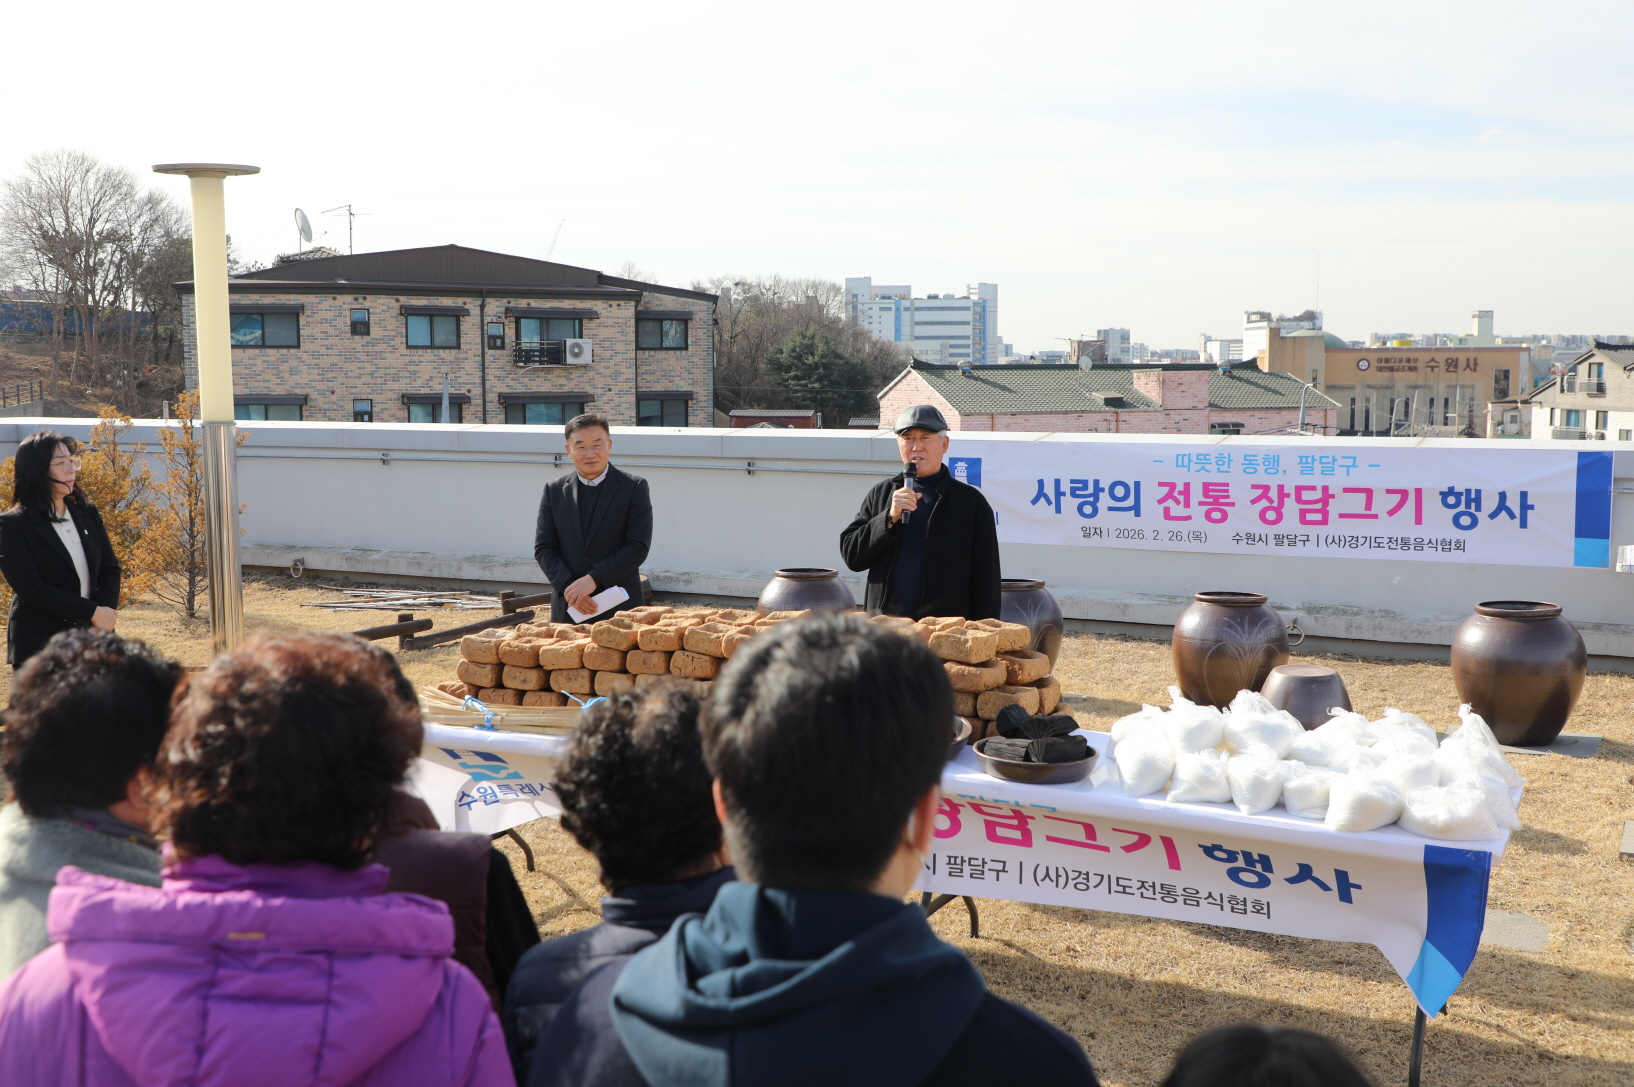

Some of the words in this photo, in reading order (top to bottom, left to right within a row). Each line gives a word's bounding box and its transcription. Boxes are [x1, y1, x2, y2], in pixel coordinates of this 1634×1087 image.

[1425, 357, 1479, 373] 수원사
[1175, 453, 1233, 475] 따뜻한
[1241, 454, 1287, 476] 동행,
[1297, 454, 1359, 477] 팔달구
[1030, 478, 1142, 519] 사랑의
[1156, 481, 1236, 525] 전통
[1249, 483, 1423, 527] 장담그기
[1438, 485, 1535, 532] 행사
[1080, 526, 1104, 539] 일자
[1115, 528, 1149, 541] 2026.
[1153, 529, 1164, 542] 2.
[1231, 532, 1269, 547] 수원시
[1273, 532, 1312, 548] 팔달구
[1324, 534, 1467, 553] (사)경기도전통음식협회
[1197, 843, 1363, 905] 행사
[945, 855, 1009, 882] 팔달구
[1032, 863, 1272, 920] (사)경기도전통음식협회
